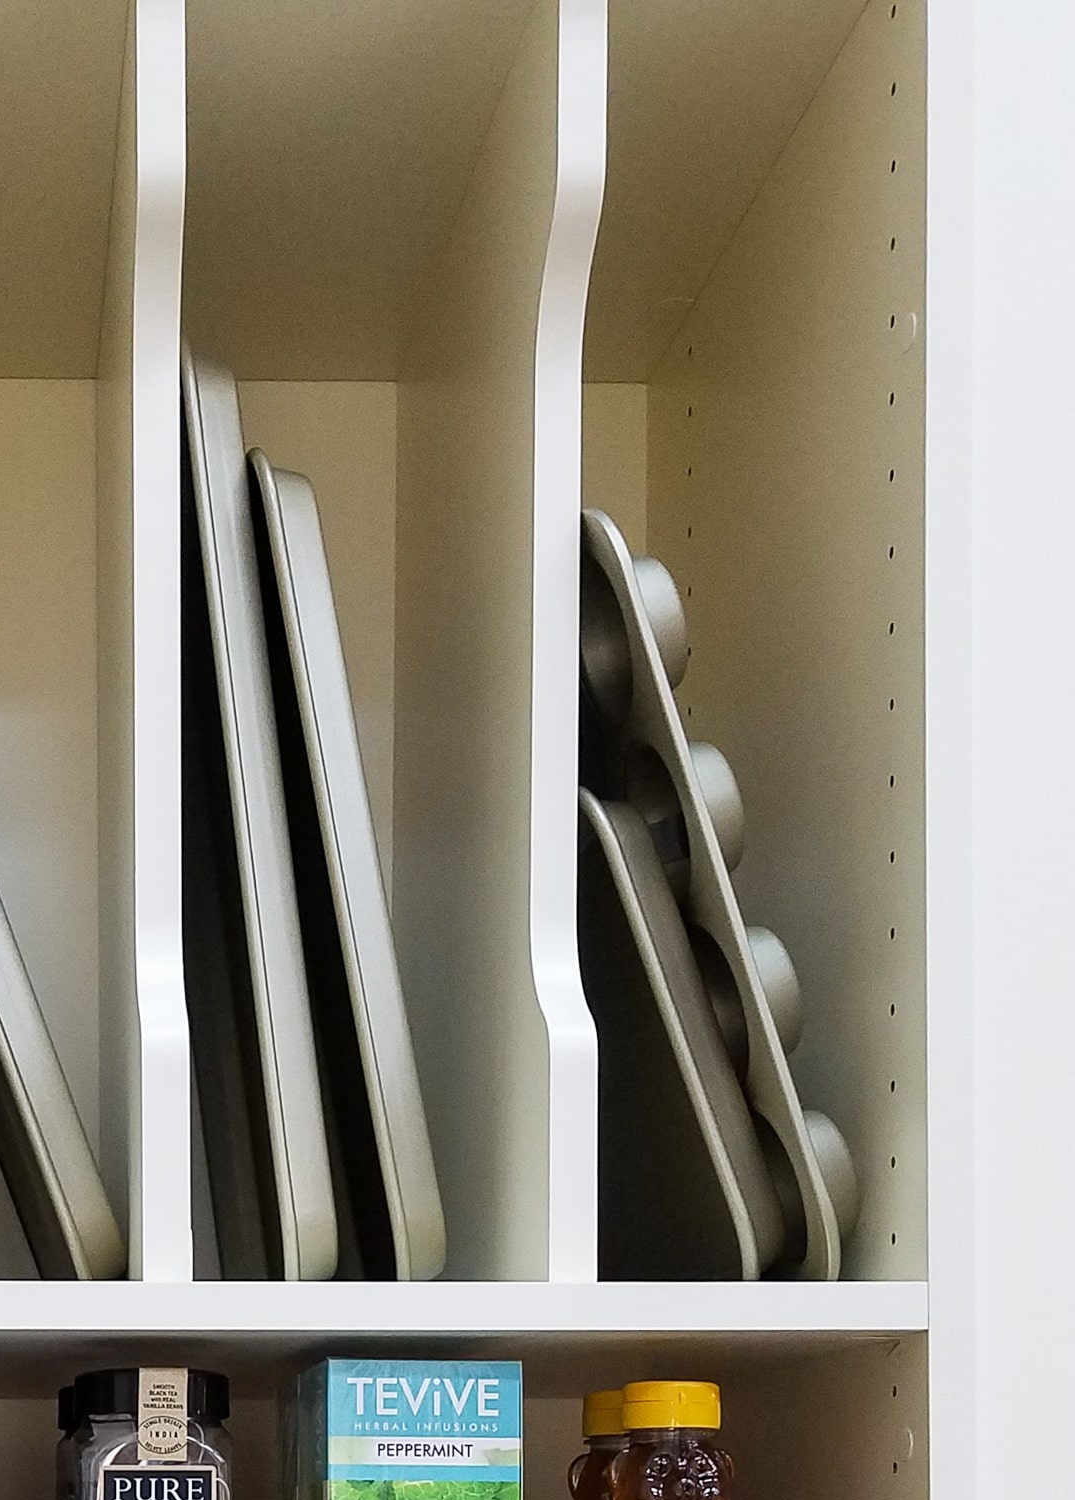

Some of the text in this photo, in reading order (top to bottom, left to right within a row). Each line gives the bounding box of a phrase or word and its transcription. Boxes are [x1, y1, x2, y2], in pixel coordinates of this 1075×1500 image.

[354, 1421, 499, 1433] HERBAL INFUSIONS
[377, 1443, 474, 1458] PEPPERMINT
